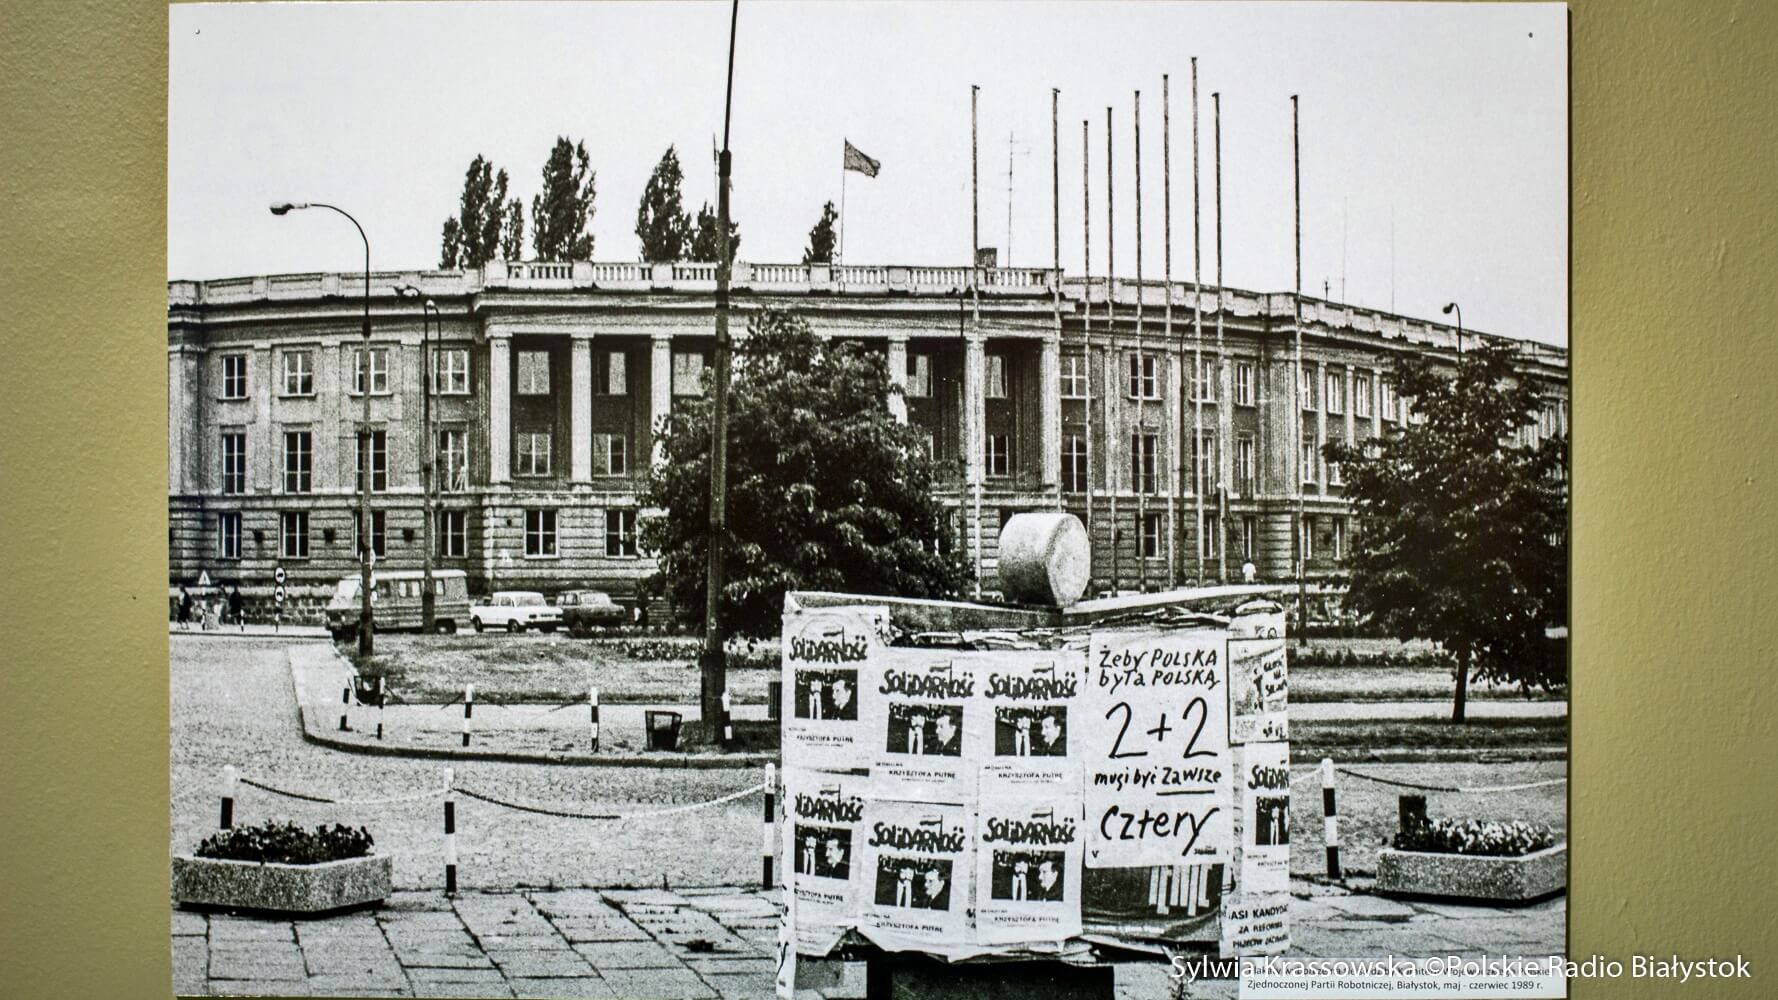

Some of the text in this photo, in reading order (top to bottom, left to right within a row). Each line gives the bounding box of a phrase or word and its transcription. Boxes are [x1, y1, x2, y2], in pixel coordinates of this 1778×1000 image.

[1100, 644, 1218, 669] Żeby POLSKA
[1229, 909, 1248, 920] ASI
[1247, 980, 1309, 990] Zjednoczonej
[1311, 980, 1335, 989] Partii
[1338, 980, 1394, 990] Robotniczej,
[1397, 980, 1441, 991] Białystok,
[1444, 981, 1461, 991] maj
[1469, 980, 1508, 989] czerwiec
[1512, 980, 1534, 989] 1989
